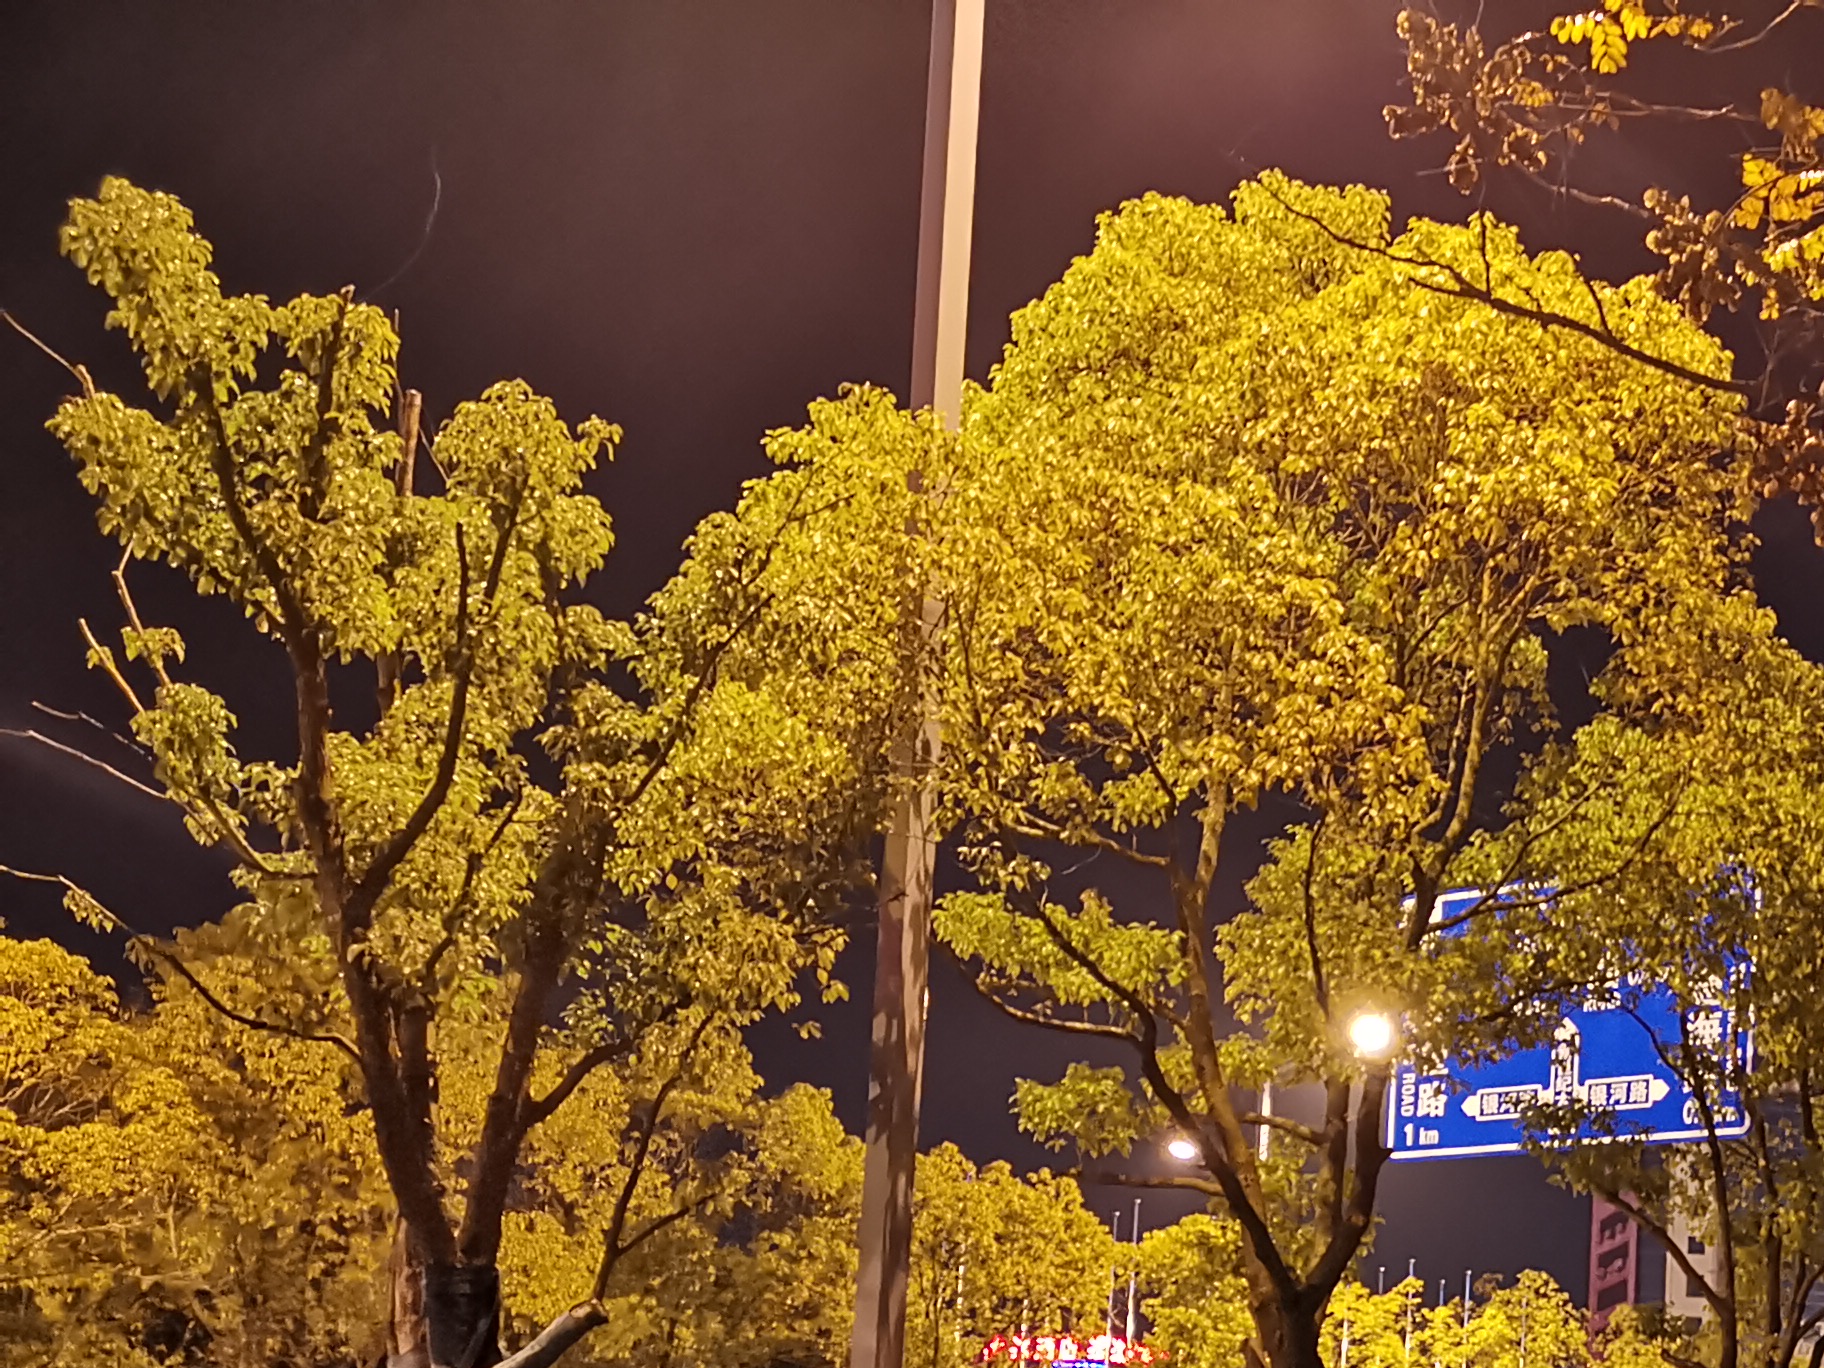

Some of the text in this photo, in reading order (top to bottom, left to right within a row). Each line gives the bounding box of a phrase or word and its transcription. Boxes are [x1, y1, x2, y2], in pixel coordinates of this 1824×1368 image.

[1400, 1072, 1416, 1117] ROAD
[1590, 1081, 1648, 1106] 银河路
